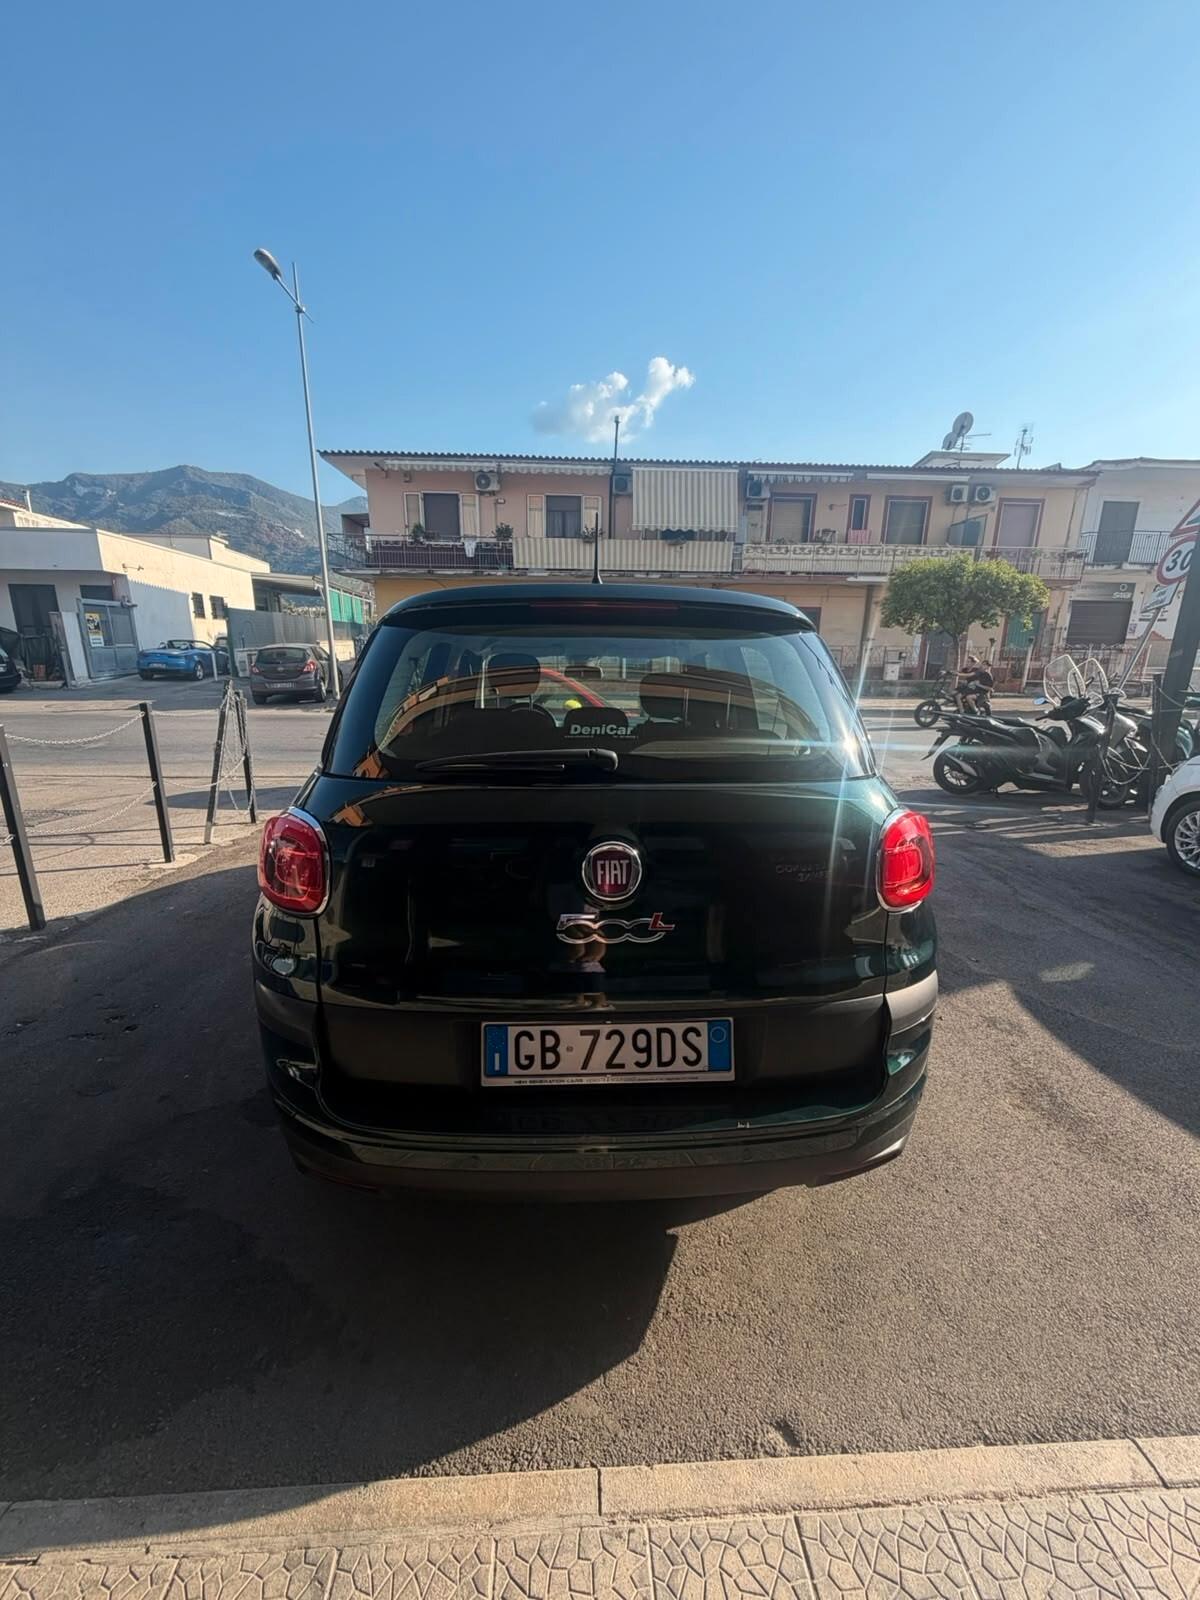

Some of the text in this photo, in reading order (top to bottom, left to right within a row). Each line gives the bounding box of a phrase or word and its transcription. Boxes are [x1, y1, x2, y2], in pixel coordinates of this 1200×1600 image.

[1165, 549, 1193, 573] 30
[570, 724, 634, 735] DeniCar
[596, 860, 630, 885] FIAT
[514, 1029, 561, 1071] GB
[579, 1026, 703, 1071] 729DS
